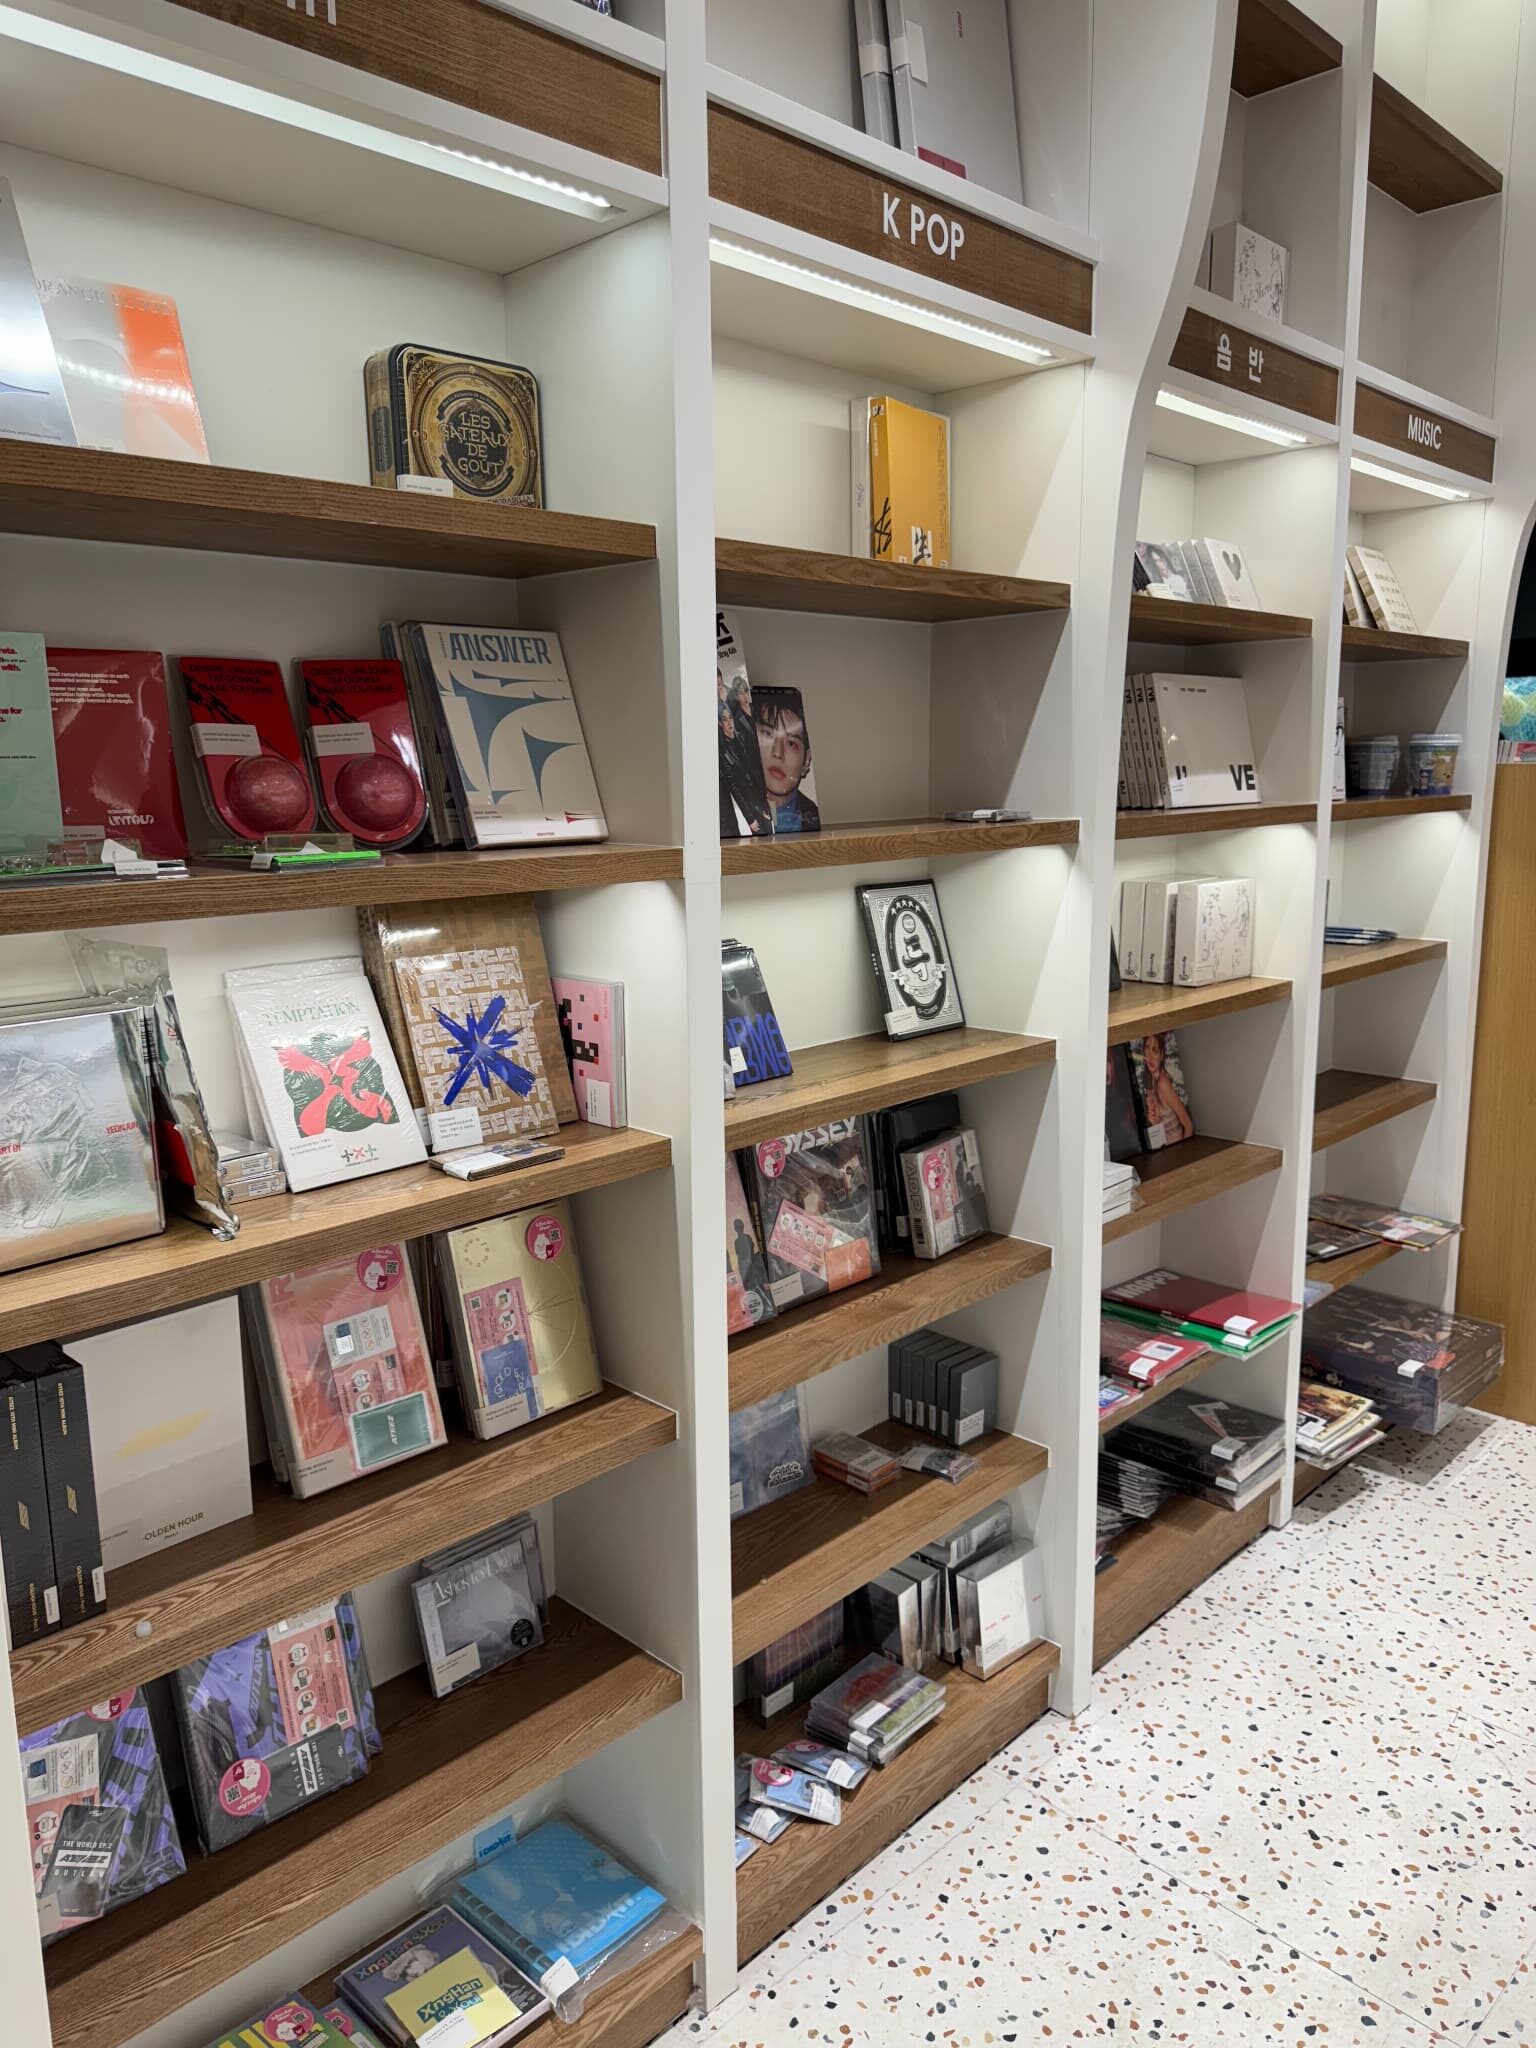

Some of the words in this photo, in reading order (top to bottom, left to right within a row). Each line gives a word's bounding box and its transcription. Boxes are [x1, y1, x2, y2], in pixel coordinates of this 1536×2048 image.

[883, 192, 901, 239] K
[910, 204, 965, 260] POP
[460, 412, 491, 429] LES
[1408, 414, 1442, 450] MUSIC
[465, 443, 488, 458] DE
[450, 632, 552, 665] ANSWER
[1229, 764, 1256, 791] VE
[177, 1511, 204, 1529] HOUR
[419, 1978, 482, 2020] XngHan
